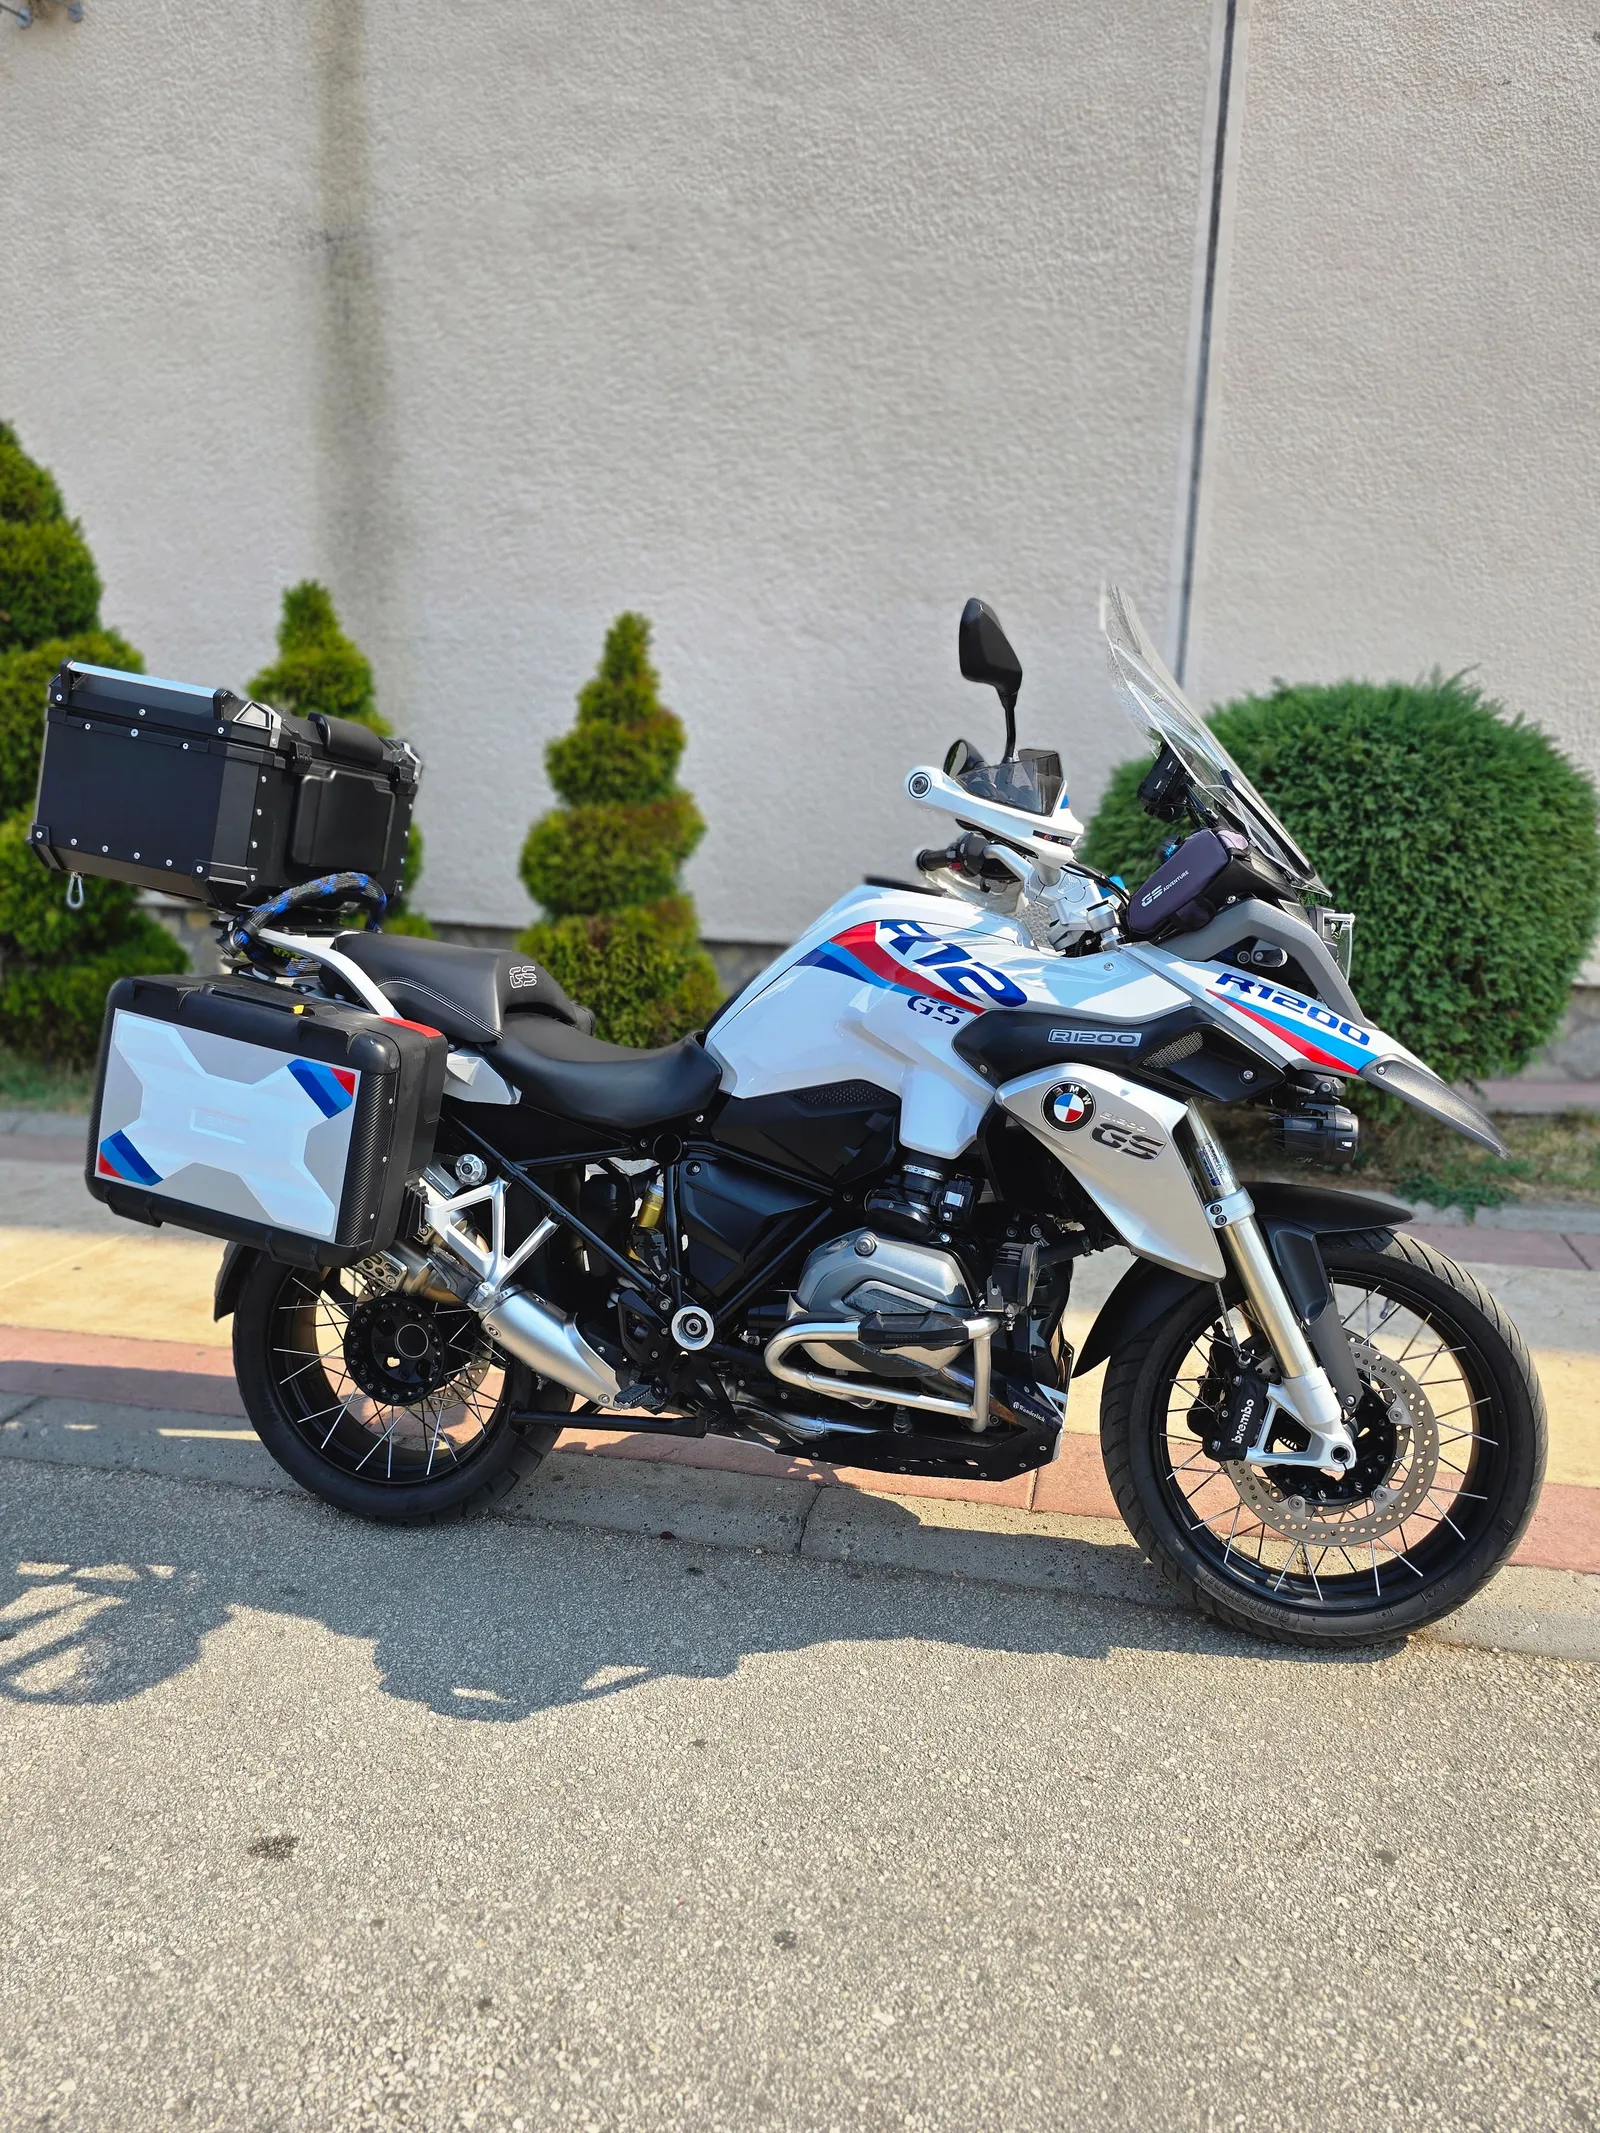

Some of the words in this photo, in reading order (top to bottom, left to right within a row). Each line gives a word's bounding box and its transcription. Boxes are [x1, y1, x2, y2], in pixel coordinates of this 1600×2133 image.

[1141, 885, 1163, 907] GS
[1163, 870, 1190, 892] ADVENTURE
[509, 965, 538, 989] GS
[906, 995, 966, 1026] GS
[1215, 972, 1370, 1046] R1200
[1050, 1030, 1138, 1044] R1200
[1052, 1084, 1093, 1105] BMW
[1091, 1123, 1166, 1160] GS
[1231, 1399, 1255, 1444] brembo
